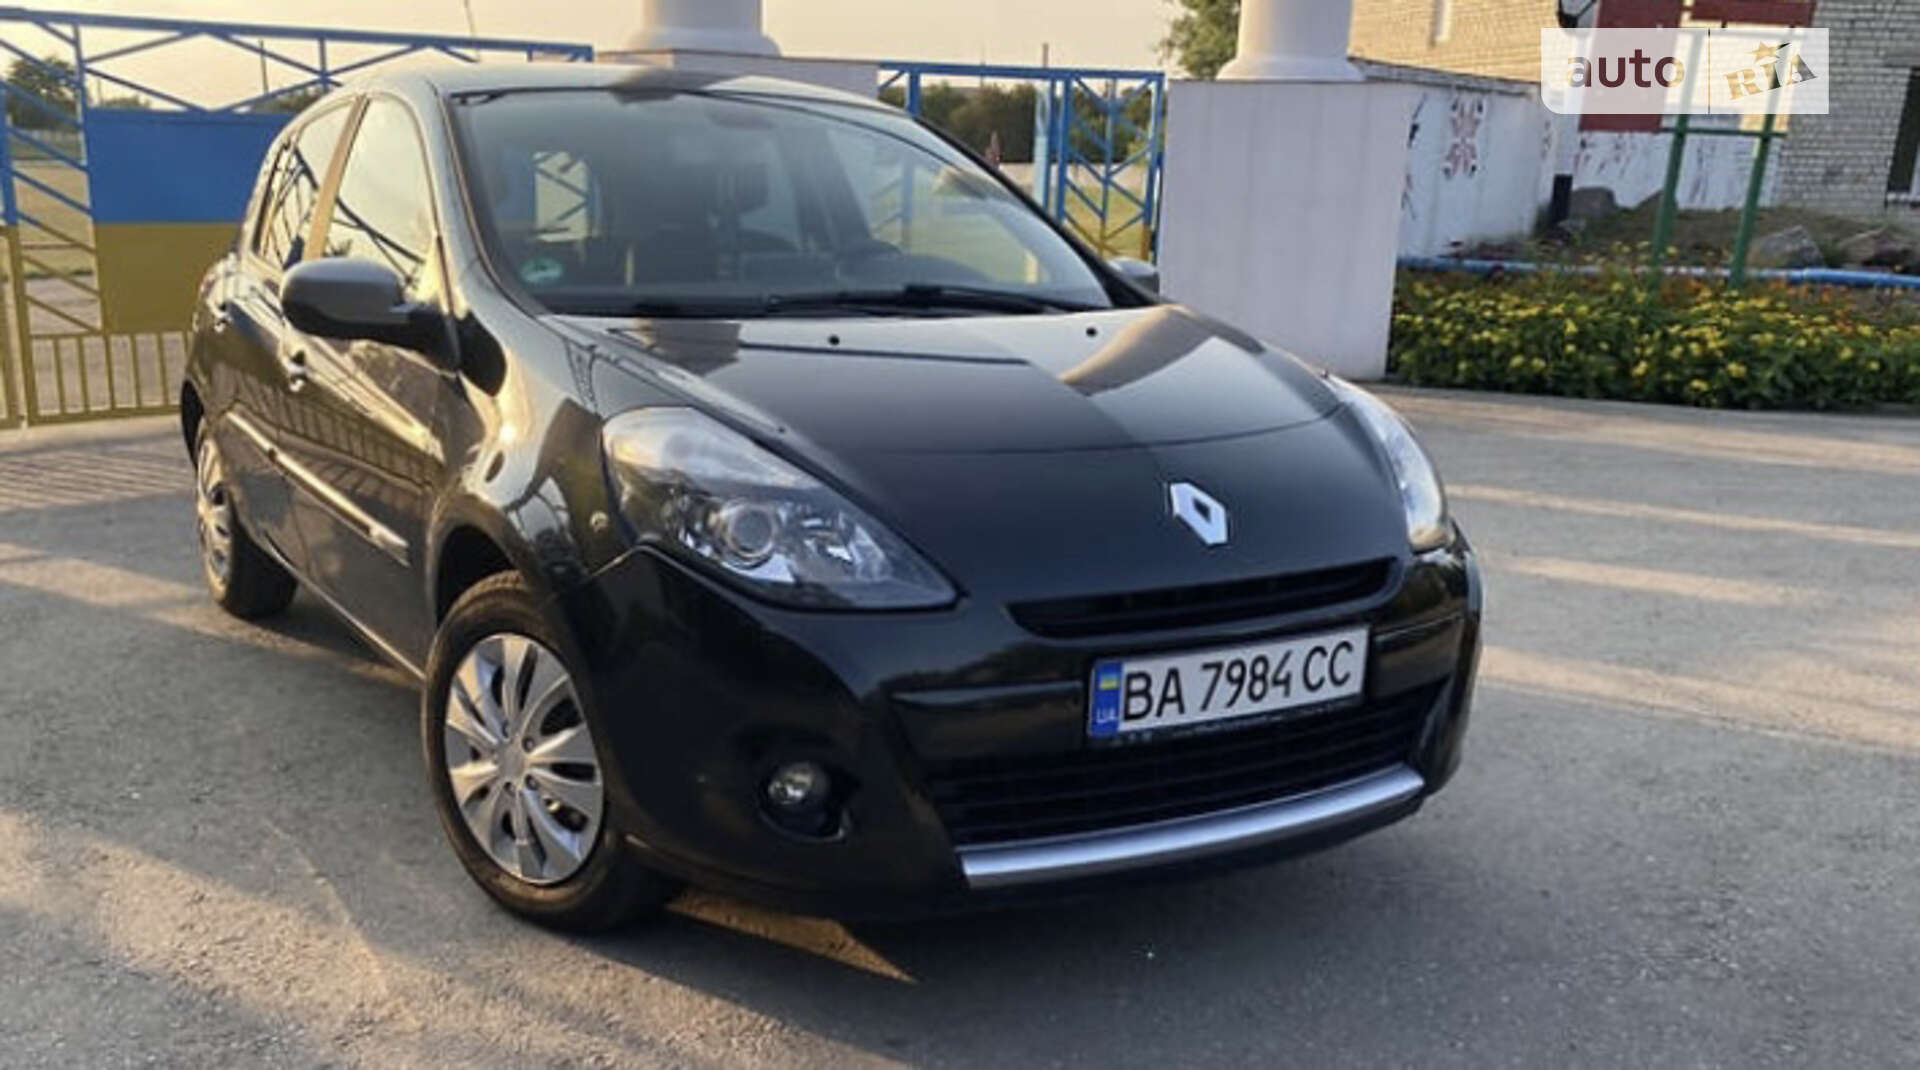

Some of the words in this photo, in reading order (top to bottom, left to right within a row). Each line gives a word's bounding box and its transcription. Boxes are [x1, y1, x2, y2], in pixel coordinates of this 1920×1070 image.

[1123, 668, 1186, 722] BA
[1200, 649, 1293, 713] 7984
[1302, 640, 1354, 693] CC
